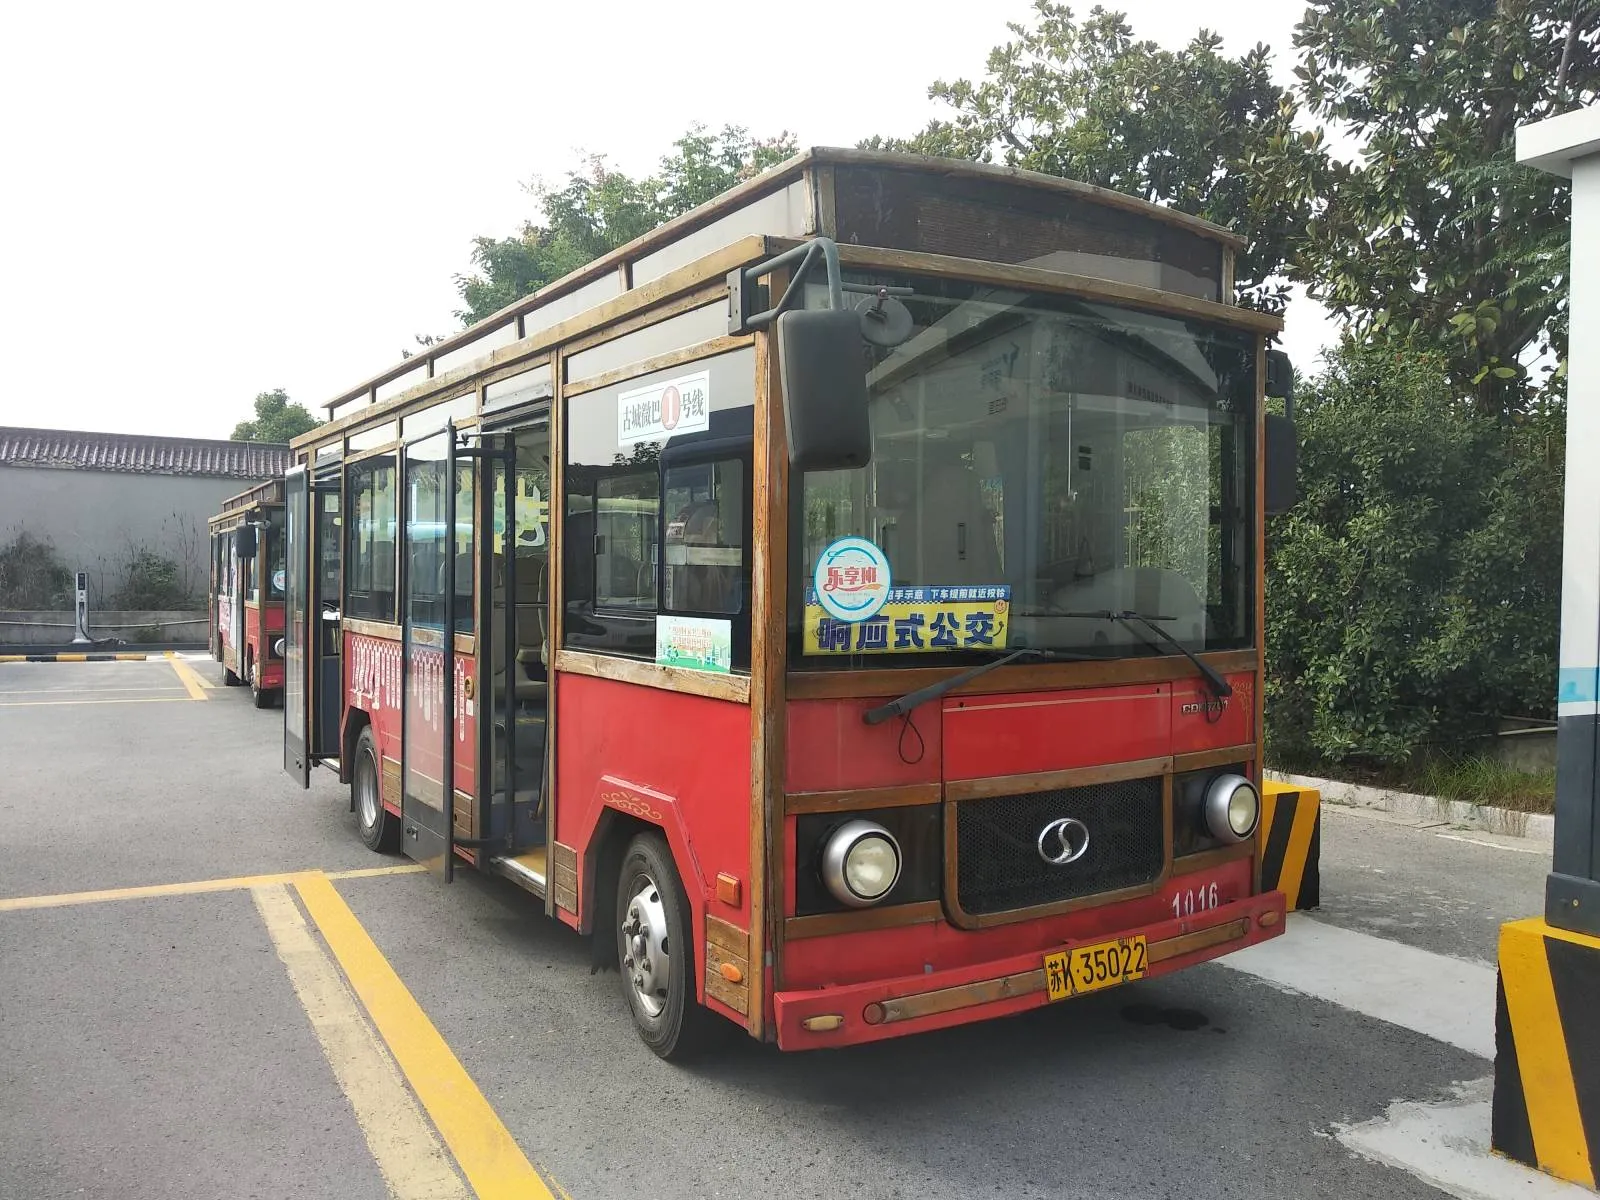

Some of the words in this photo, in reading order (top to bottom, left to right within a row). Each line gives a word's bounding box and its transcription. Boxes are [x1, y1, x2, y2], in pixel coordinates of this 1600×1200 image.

[818, 612, 994, 651] 响应式公交
[1172, 881, 1218, 918] 1016
